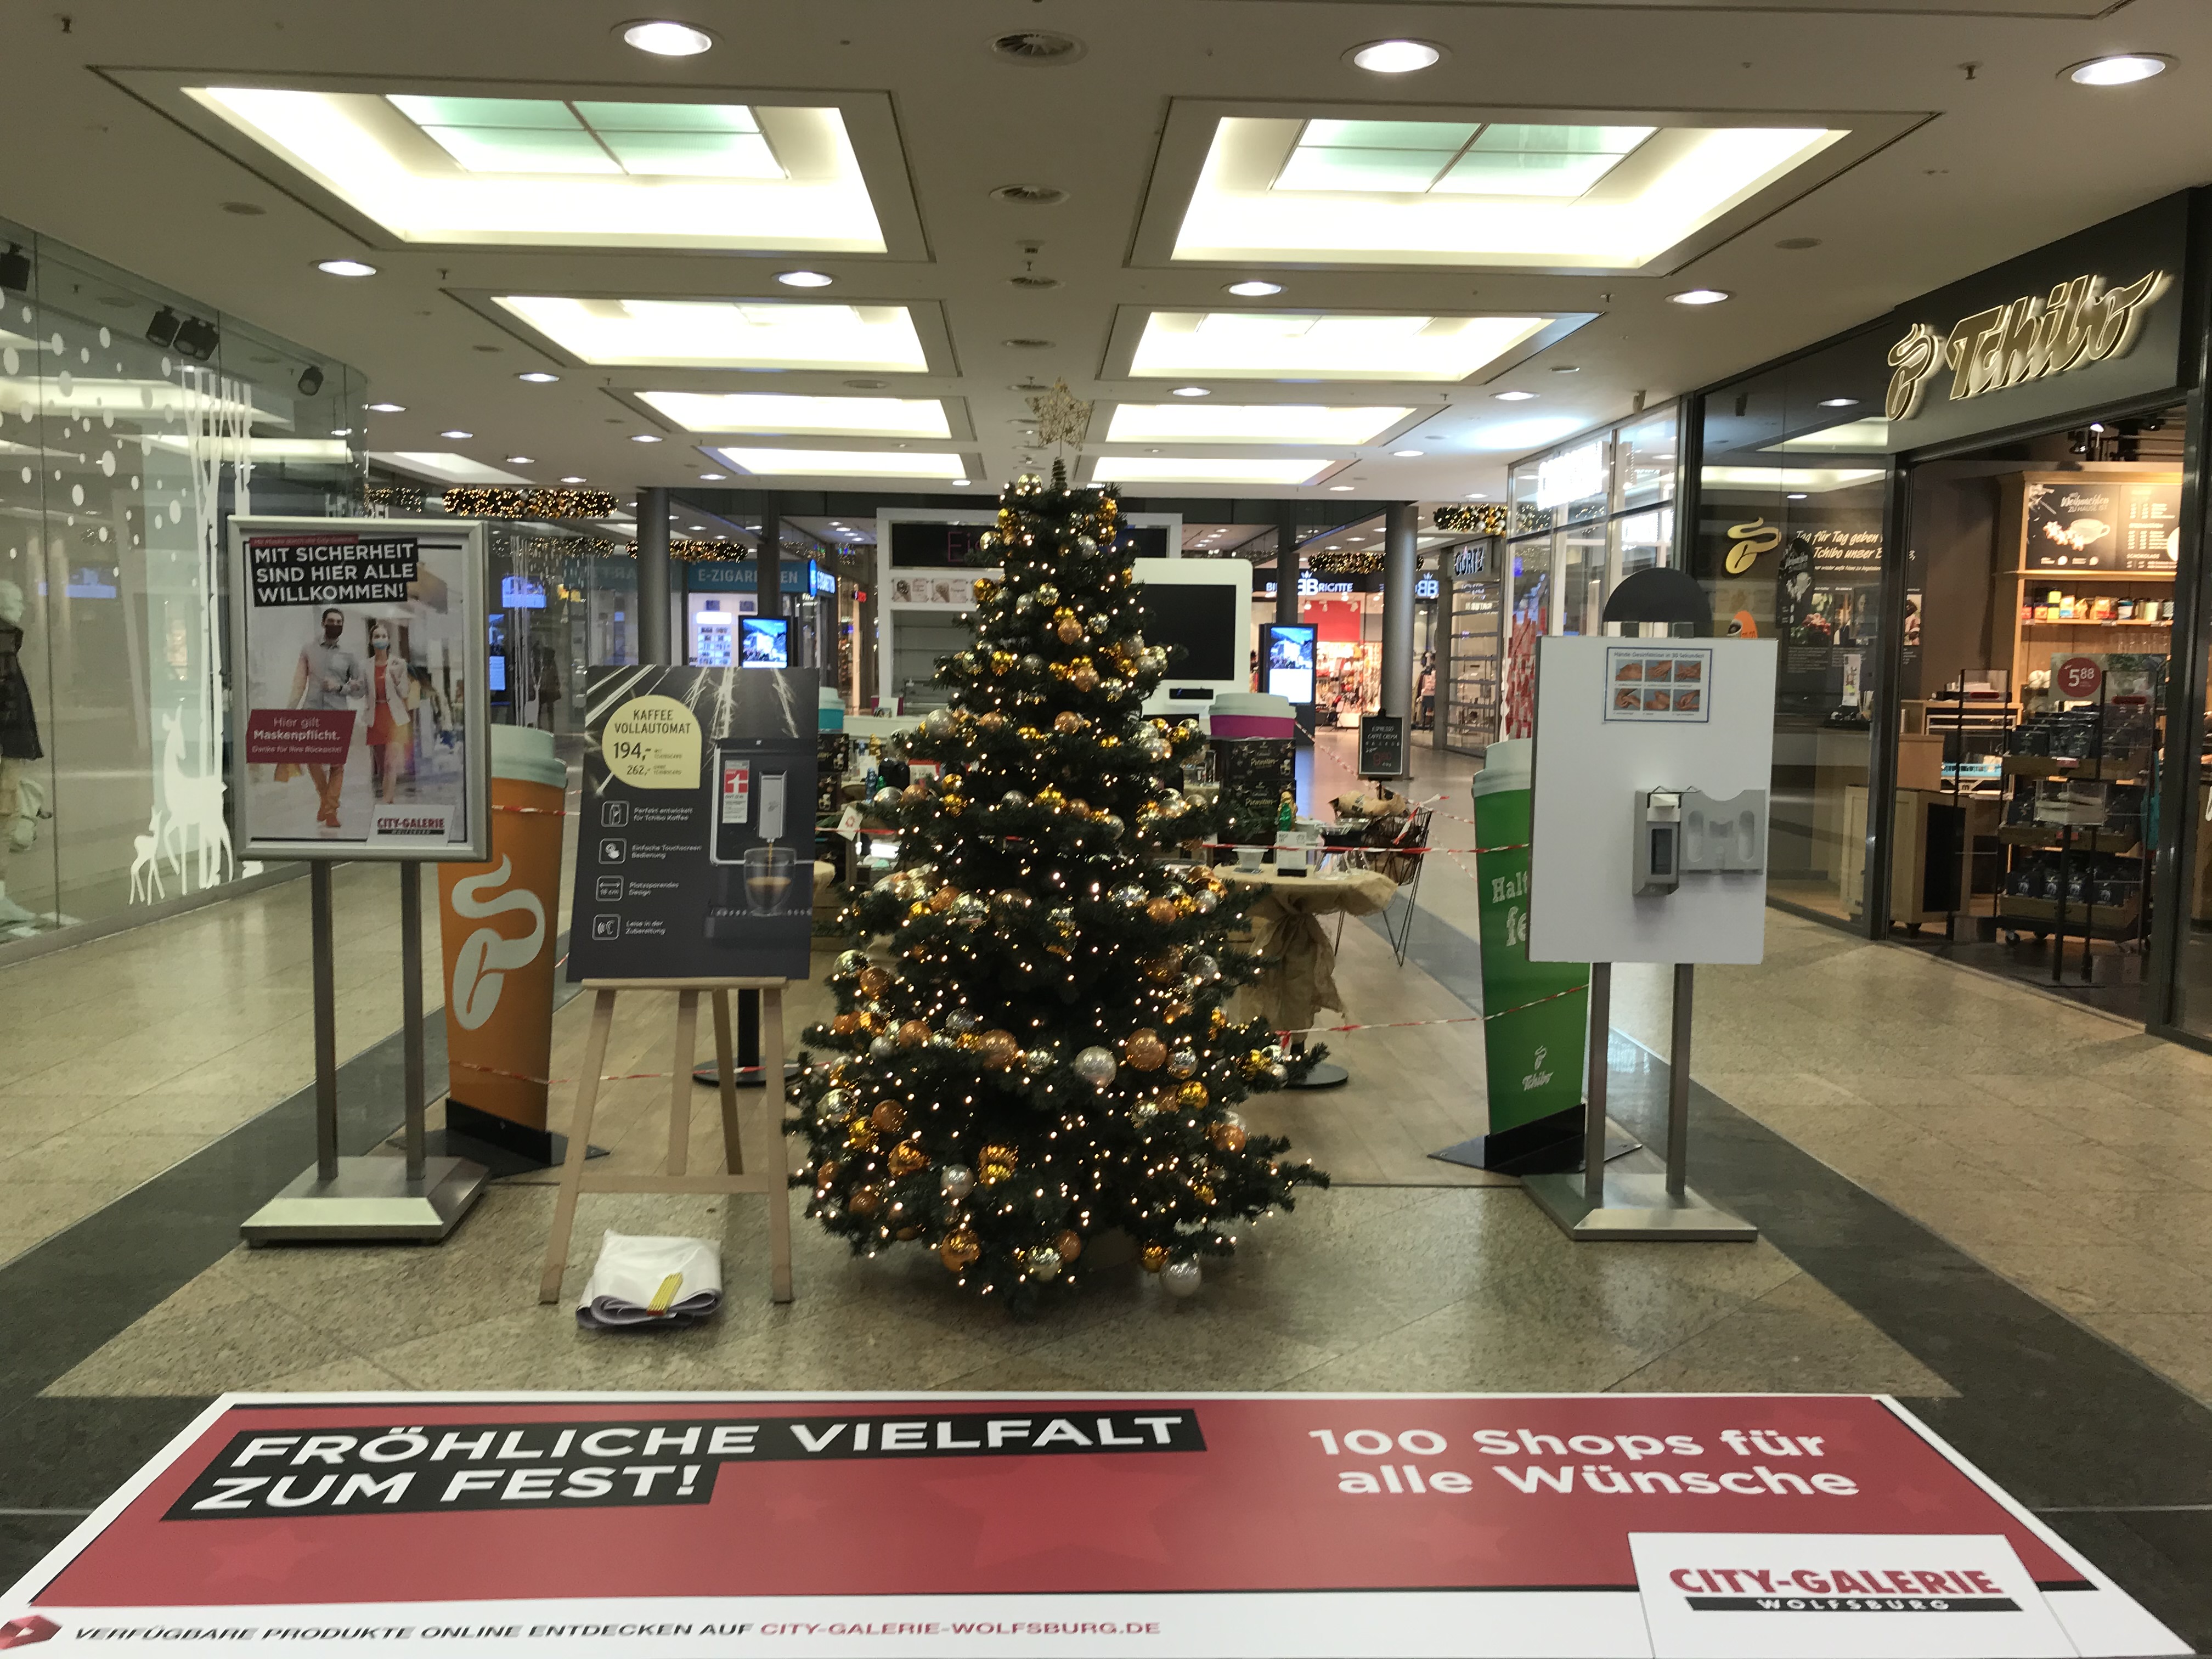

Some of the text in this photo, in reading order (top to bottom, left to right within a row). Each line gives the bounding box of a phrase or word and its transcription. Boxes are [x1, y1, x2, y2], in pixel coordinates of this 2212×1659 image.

[1944, 270, 2164, 400] Tchibo
[947, 531, 981, 562] Ei
[1812, 530, 1831, 545] für
[1832, 531, 1848, 546] Tag
[1849, 531, 1878, 546] geben
[255, 543, 414, 564] MIT SICHERHEIT
[1813, 546, 1843, 558] Tchibo
[1844, 549, 1875, 559] unser
[256, 562, 414, 583] SIND HIER ALLE
[698, 568, 798, 584] E-ZIGAREN
[257, 582, 405, 603] WILLKOMMEN!
[274, 716, 320, 729] Hier gilt
[633, 709, 674, 721] KAFFEE
[253, 729, 340, 741] Maskenpflicht.
[614, 722, 691, 734] VOLLAUTOMAT
[613, 741, 652, 761] 194,-
[627, 764, 651, 776] 262,-
[377, 817, 444, 828] CITY-GALERIE
[1506, 905, 1527, 946] fe
[1522, 1071, 1554, 1091] Tchibo
[230, 1416, 1182, 1468] FRÖHLICHE VIELFALT
[1309, 1429, 1827, 1460] 100 Shops für
[190, 1464, 701, 1511] ZUM FEST!
[1337, 1463, 1860, 1495] alle Wünsche
[1669, 1568, 2004, 1594] CITY-GALERIE
[1756, 1598, 1951, 1610] WOLFSBURG
[75, 1621, 1161, 1641] VERFÜGBARE PRODUKTE ONLINE ENTDECKEN AUF CITY-GALERIE-WOLFSBURG.DE
